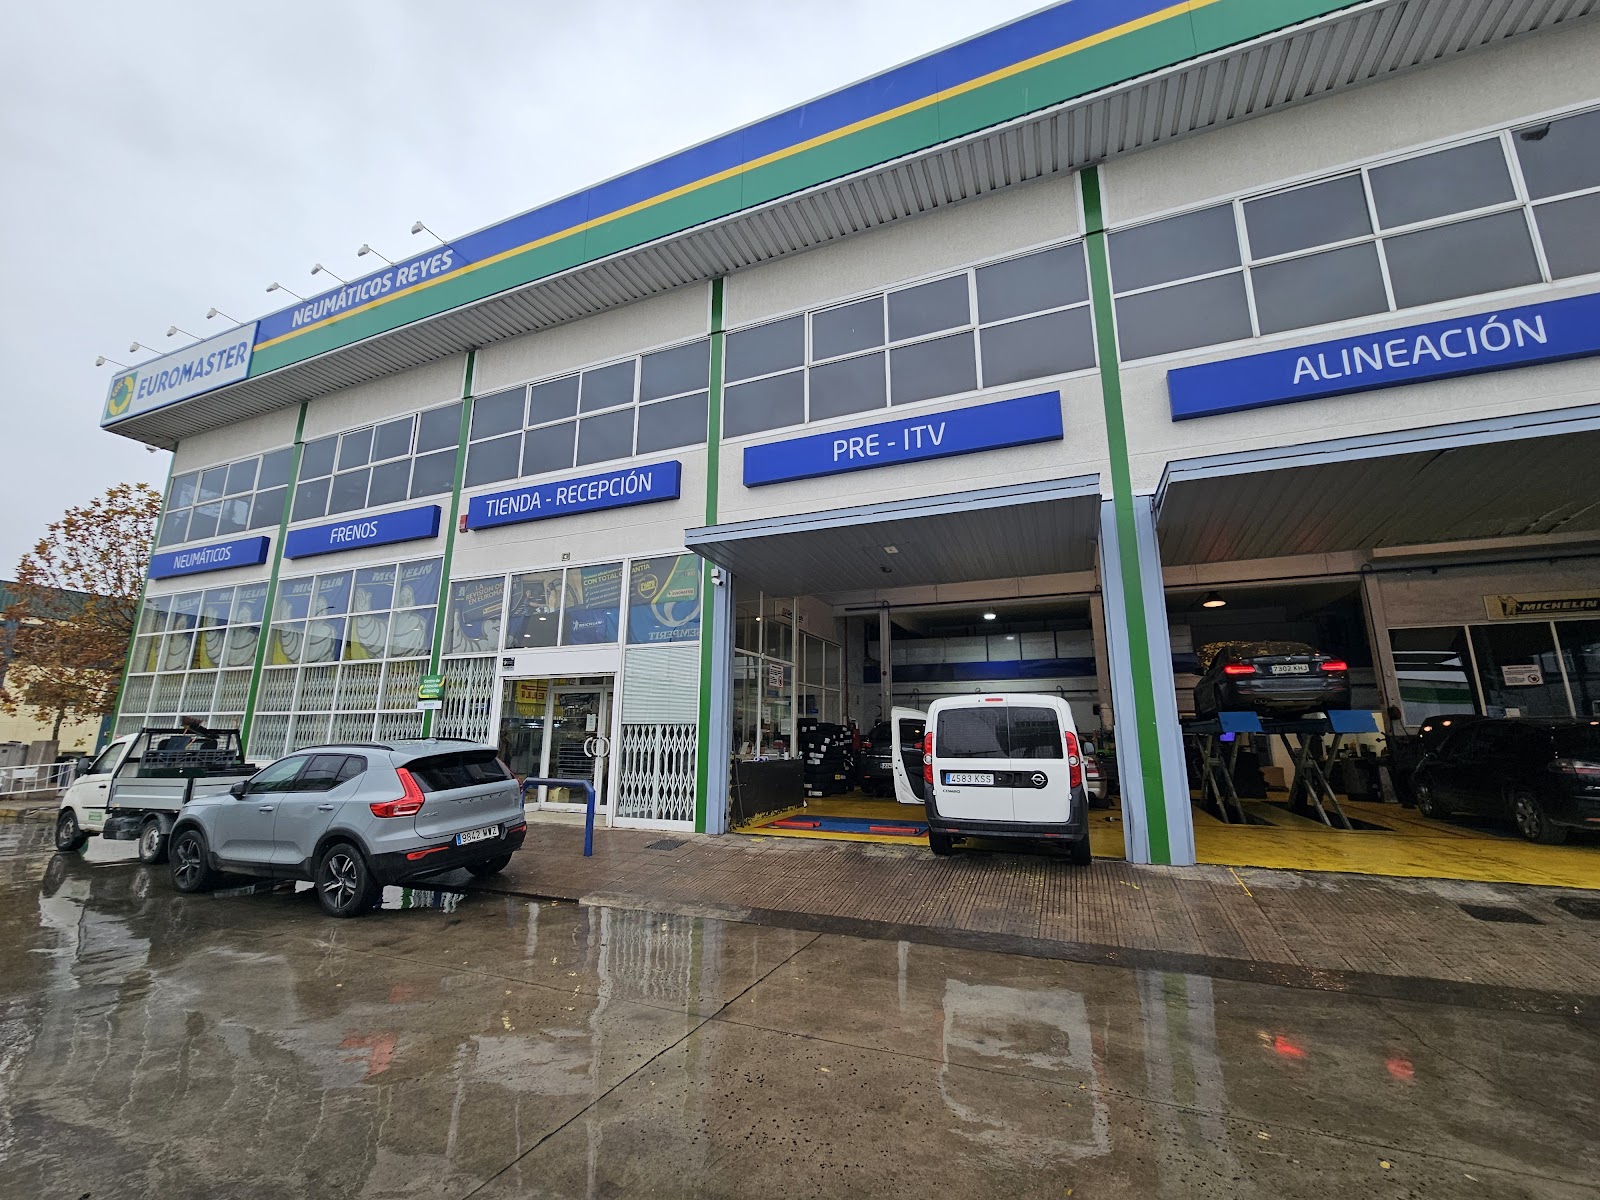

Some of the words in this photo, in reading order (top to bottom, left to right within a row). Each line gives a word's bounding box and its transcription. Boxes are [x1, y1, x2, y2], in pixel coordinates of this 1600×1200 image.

[291, 272, 392, 328] NEUMÁTICOS
[395, 249, 454, 285] REYES
[1292, 313, 1548, 385] ALINEACIÓN
[136, 340, 249, 400] EUROMASTER
[832, 433, 880, 462] PRE
[903, 421, 946, 452] ITV
[486, 491, 541, 518] TIENDA
[556, 470, 652, 506] RECEPCIÓN
[329, 521, 378, 544] FRENOS
[173, 546, 231, 570] NEUMÁTICOS
[292, 577, 344, 594] MICELIN
[1521, 600, 1598, 611] MICHELIN
[951, 774, 972, 783] 4583
[974, 774, 991, 783] KSS
[461, 830, 481, 843] 9842
